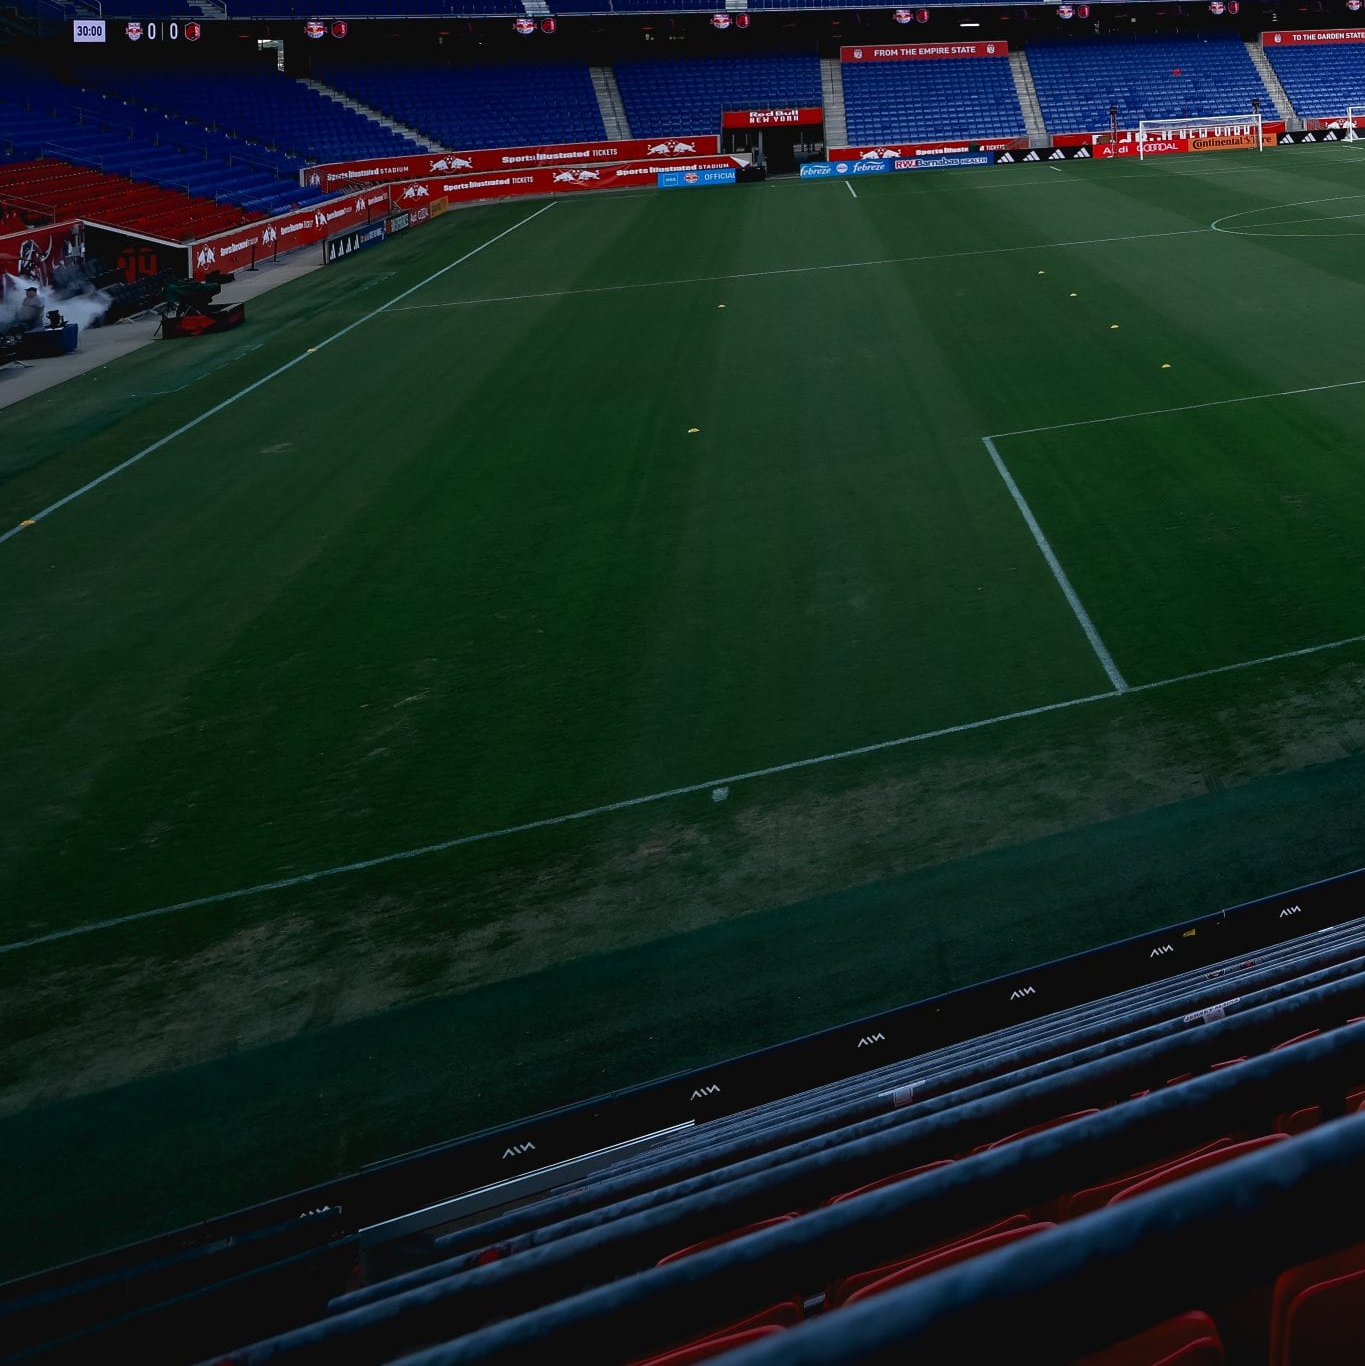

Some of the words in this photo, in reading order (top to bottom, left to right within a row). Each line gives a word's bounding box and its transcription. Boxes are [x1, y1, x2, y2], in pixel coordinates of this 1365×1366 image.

[77, 26, 102, 36] 30:00
[147, 22, 156, 40] 0
[169, 22, 178, 40] 0
[874, 49, 898, 57] FROM
[900, 48, 917, 56] THE
[919, 47, 950, 56] EMPIRE
[951, 46, 976, 54] STATE
[750, 110, 774, 118] Red
[1192, 136, 1243, 150] Continental
[502, 154, 535, 164] Sports
[536, 150, 590, 161] Illustrated
[592, 148, 618, 157] TICKETS
[960, 156, 988, 165] HEALTH
[380, 166, 408, 175] STADIUM
[616, 168, 648, 176] Sports
[649, 164, 698, 173] Illustrated
[800, 164, 832, 177] febreze
[853, 162, 886, 174] febreze
[704, 172, 736, 180] OFFICIAL
[443, 182, 469, 192] Sports
[469, 178, 510, 189] Illustrated
[512, 176, 534, 185] TICKETS
